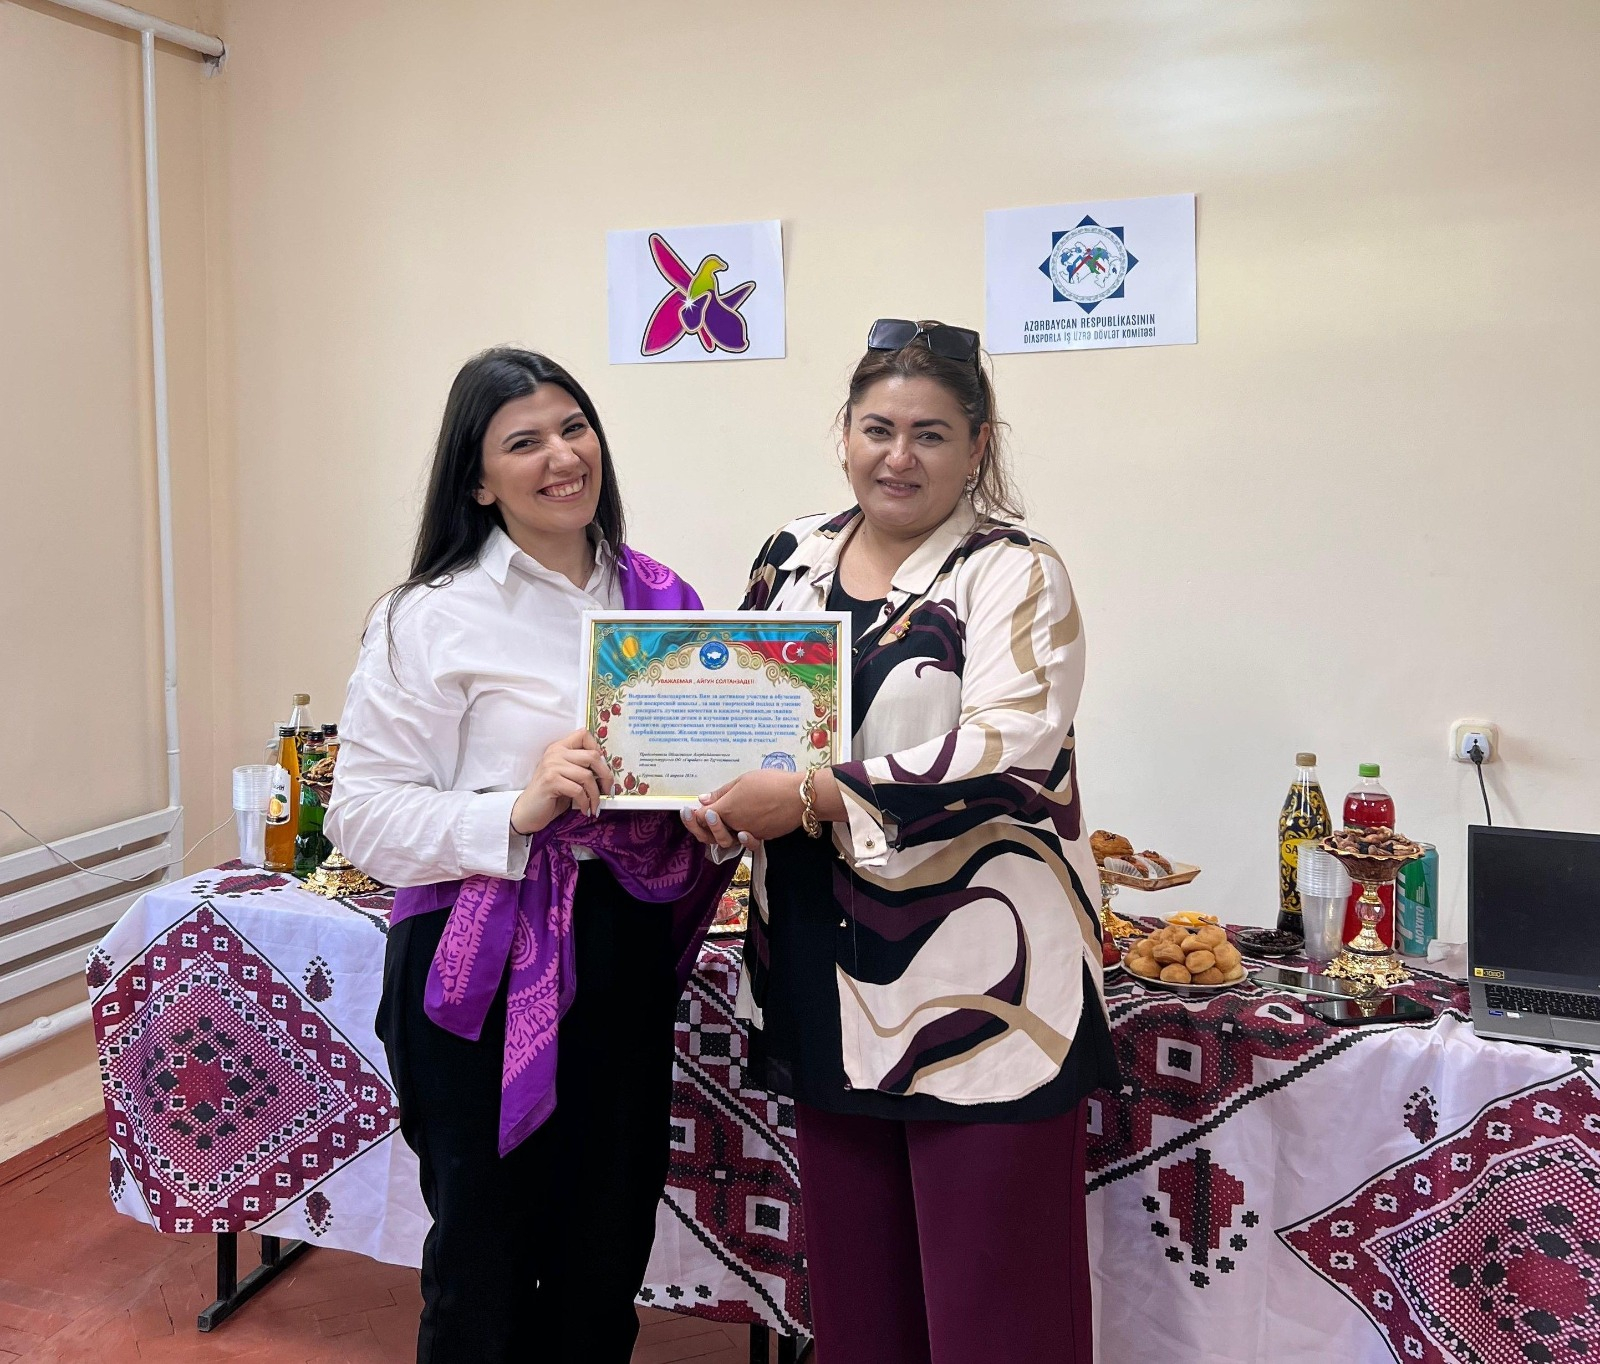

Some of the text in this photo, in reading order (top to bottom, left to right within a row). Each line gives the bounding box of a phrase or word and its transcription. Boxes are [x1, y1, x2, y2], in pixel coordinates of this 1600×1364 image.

[1024, 314, 1155, 332] AZƏRBAYCAN RESPUBLİKASININ
[1415, 905, 1425, 945] МОХИТО
